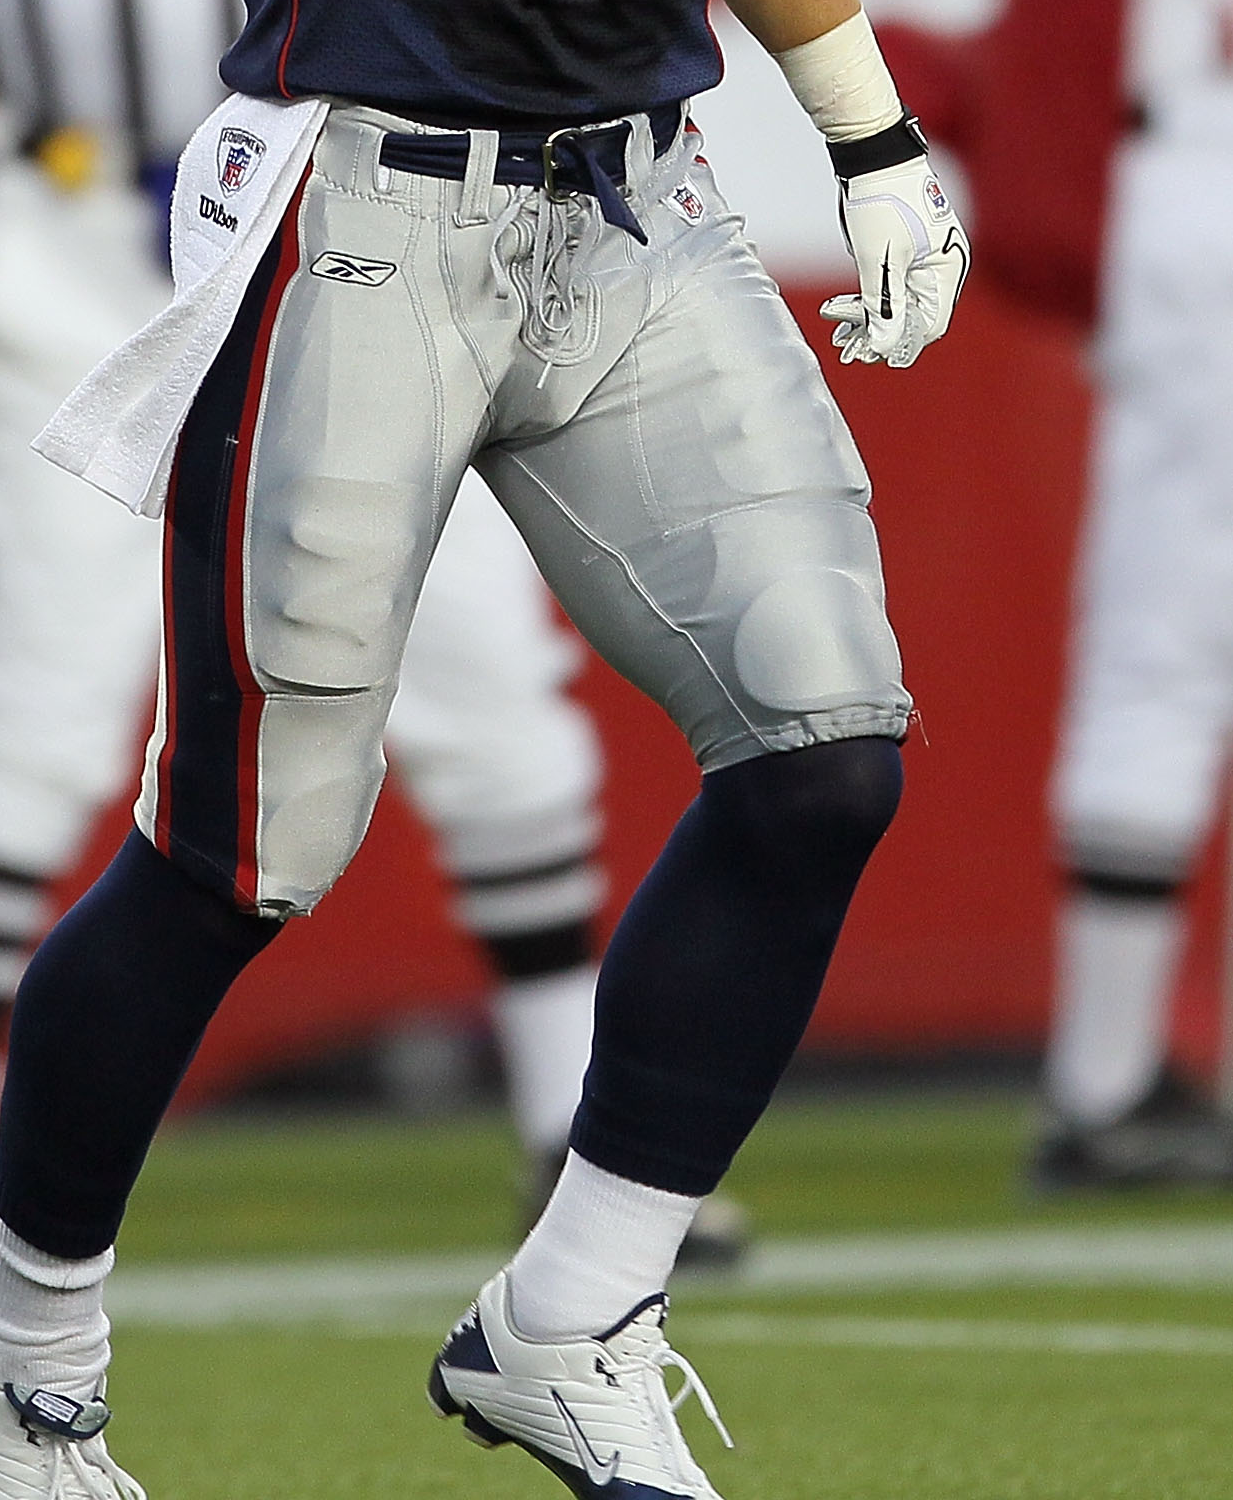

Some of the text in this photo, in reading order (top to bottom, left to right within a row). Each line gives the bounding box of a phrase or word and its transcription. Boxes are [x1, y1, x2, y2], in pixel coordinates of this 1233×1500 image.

[222, 130, 267, 158] EQUIPMENT
[223, 163, 247, 188] NFL
[199, 193, 239, 234] Wilson
